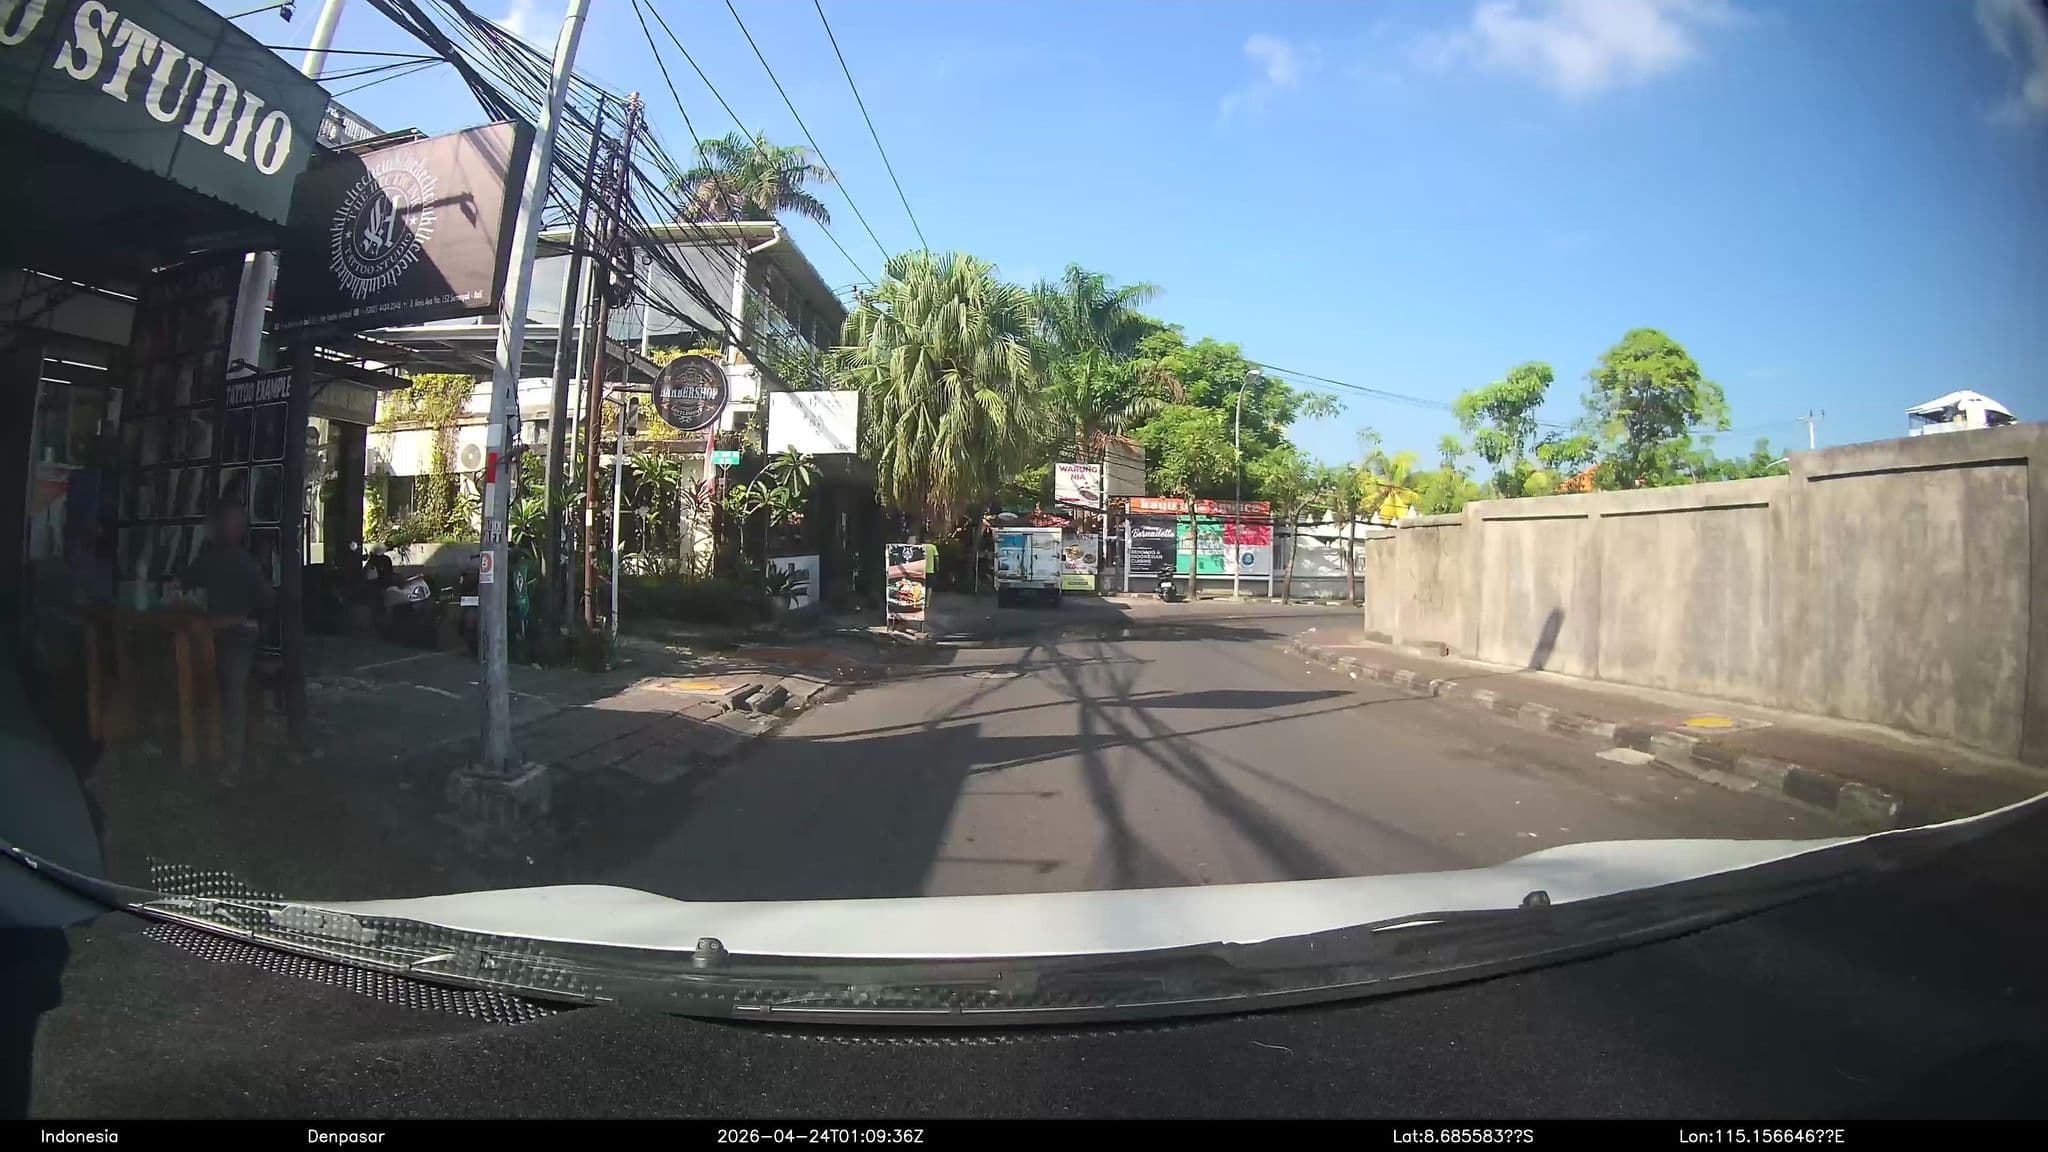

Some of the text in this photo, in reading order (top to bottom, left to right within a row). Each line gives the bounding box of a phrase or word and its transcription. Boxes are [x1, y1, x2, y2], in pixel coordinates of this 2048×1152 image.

[53, 0, 293, 176] STUDIO
[227, 376, 291, 407] TATTOO EXAMPLE
[660, 386, 719, 400] BARBERSHOP
[1059, 464, 1098, 473] WARUNG
